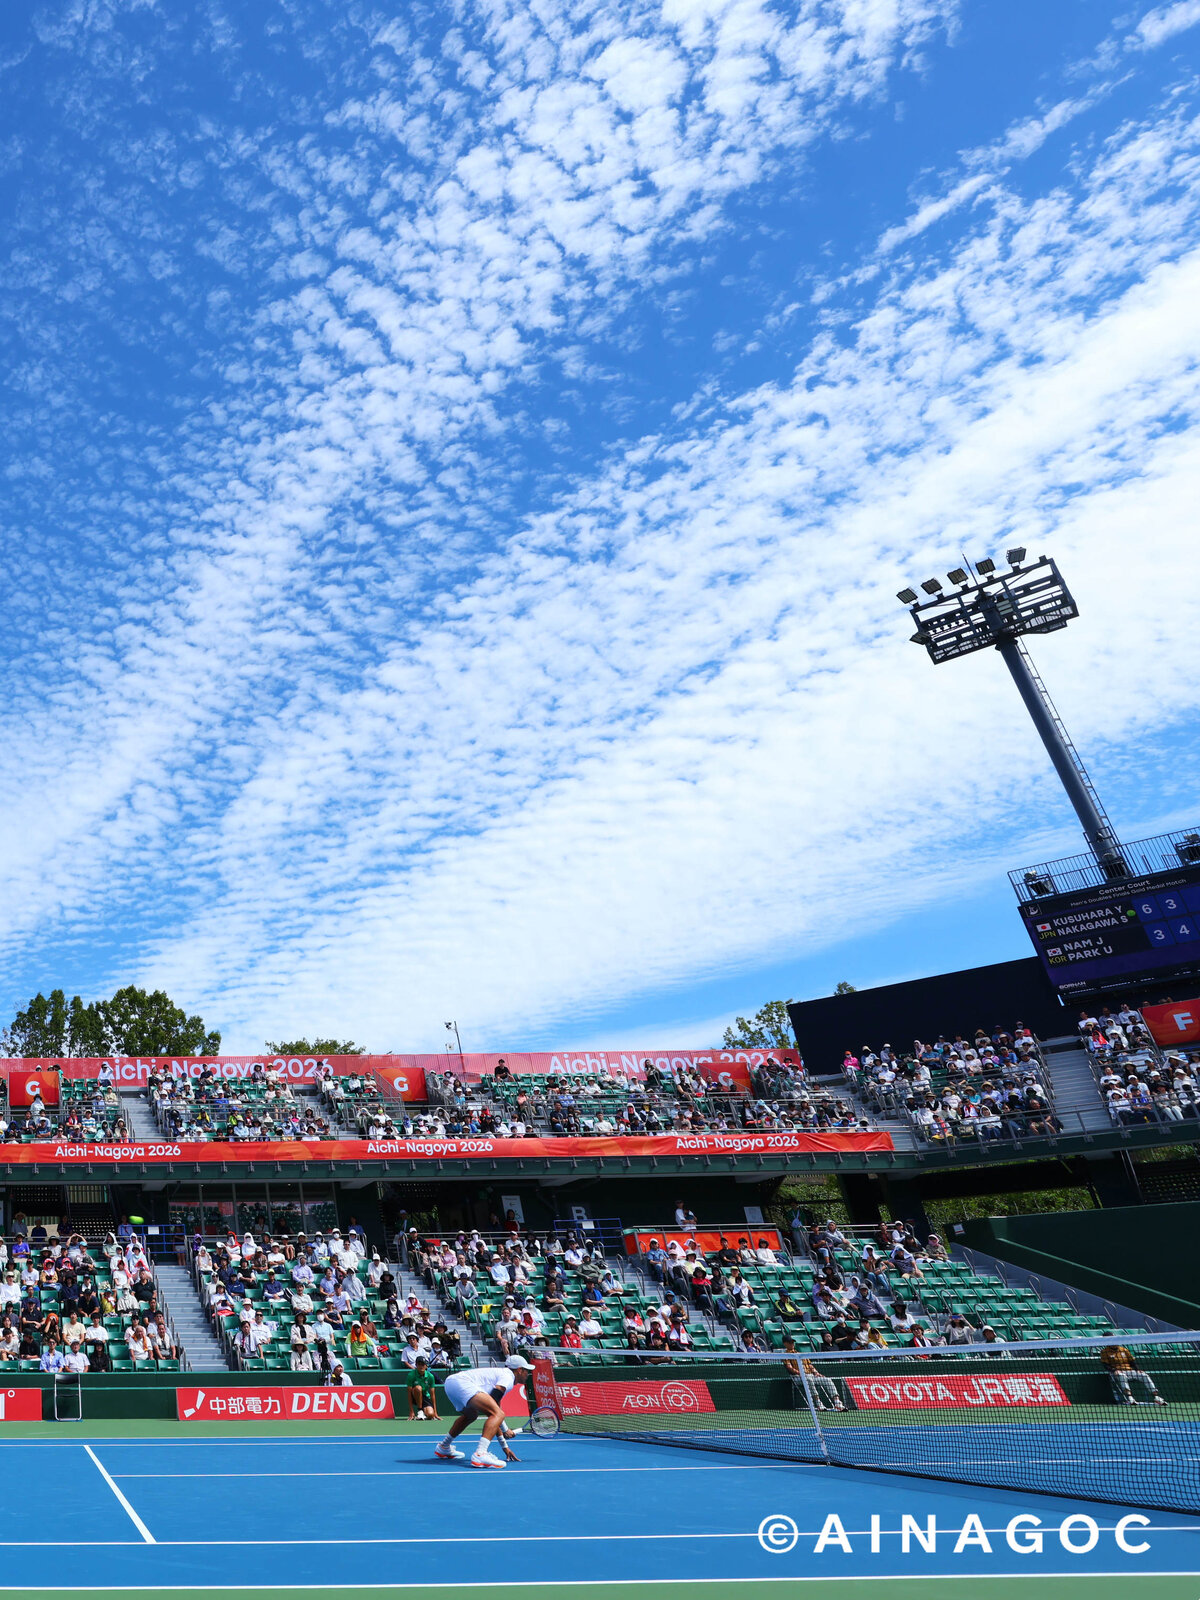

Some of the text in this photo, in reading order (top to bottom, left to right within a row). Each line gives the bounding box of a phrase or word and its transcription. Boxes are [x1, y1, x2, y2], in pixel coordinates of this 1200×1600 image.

[1088, 895, 1112, 904] Doubles
[1113, 891, 1130, 899] Finals
[1147, 884, 1165, 892] Medal
[1166, 879, 1187, 887] Match
[1098, 880, 1151, 895] Center Court
[1141, 899, 1177, 914] 6 3
[1053, 905, 1122, 927] KUSUHARA Y
[1039, 915, 1129, 940] JPN NAKAGAWA S
[1153, 924, 1190, 940] 3 4
[1063, 937, 1104, 951] NAM J
[1048, 945, 1113, 965] KOR PARK U
[1172, 1012, 1194, 1031] F
[393, 1076, 409, 1092] G
[718, 1071, 733, 1087] G
[26, 1080, 41, 1096] G
[367, 1140, 494, 1156] Aichi-Nagoya 2026
[676, 1135, 799, 1151] Aichi-Nagoya 2026
[55, 1145, 181, 1160] Aichi-Nagoya 2026
[571, 1206, 588, 1224] B
[853, 1382, 956, 1403] TOYOTA
[963, 1376, 1063, 1404] JR東海
[209, 1396, 281, 1415] 中部電力
[291, 1391, 387, 1413] DENSO
